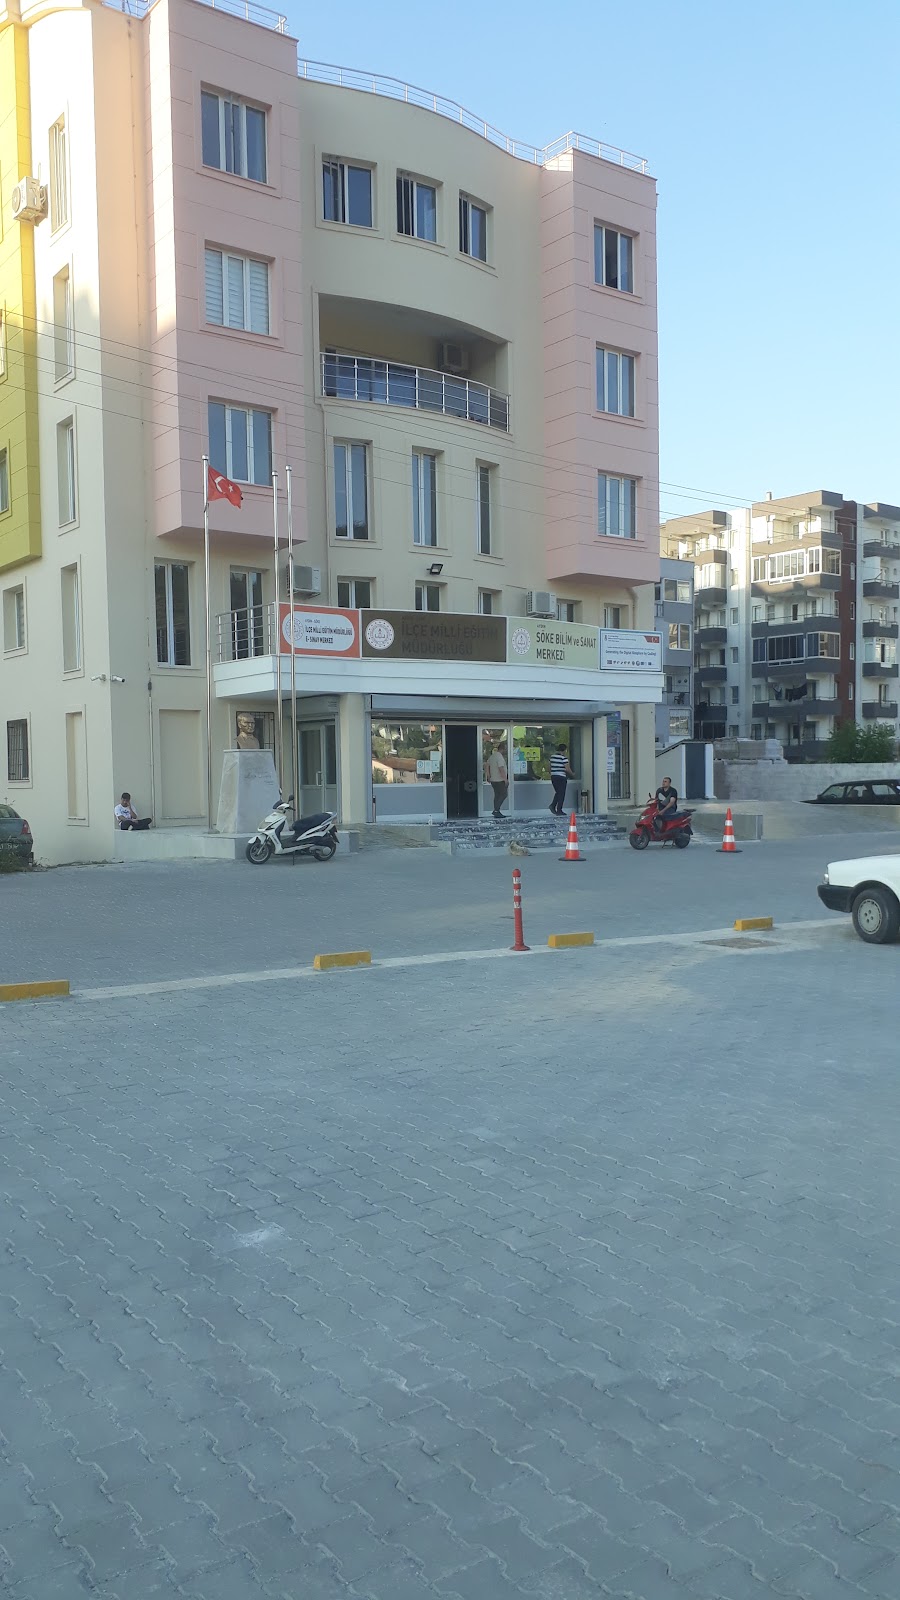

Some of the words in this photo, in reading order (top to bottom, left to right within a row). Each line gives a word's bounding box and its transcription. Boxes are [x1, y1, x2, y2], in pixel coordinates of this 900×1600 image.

[402, 621, 427, 638] İLÇE
[430, 624, 461, 638] MİLLİ
[536, 630, 554, 643] SÖKE
[556, 631, 572, 645] BİLİM
[573, 638, 579, 646] ve
[580, 636, 597, 648] SANAT
[402, 640, 473, 655] MÜDÜRLÜĞÜ
[536, 647, 565, 660] MERKEZİ
